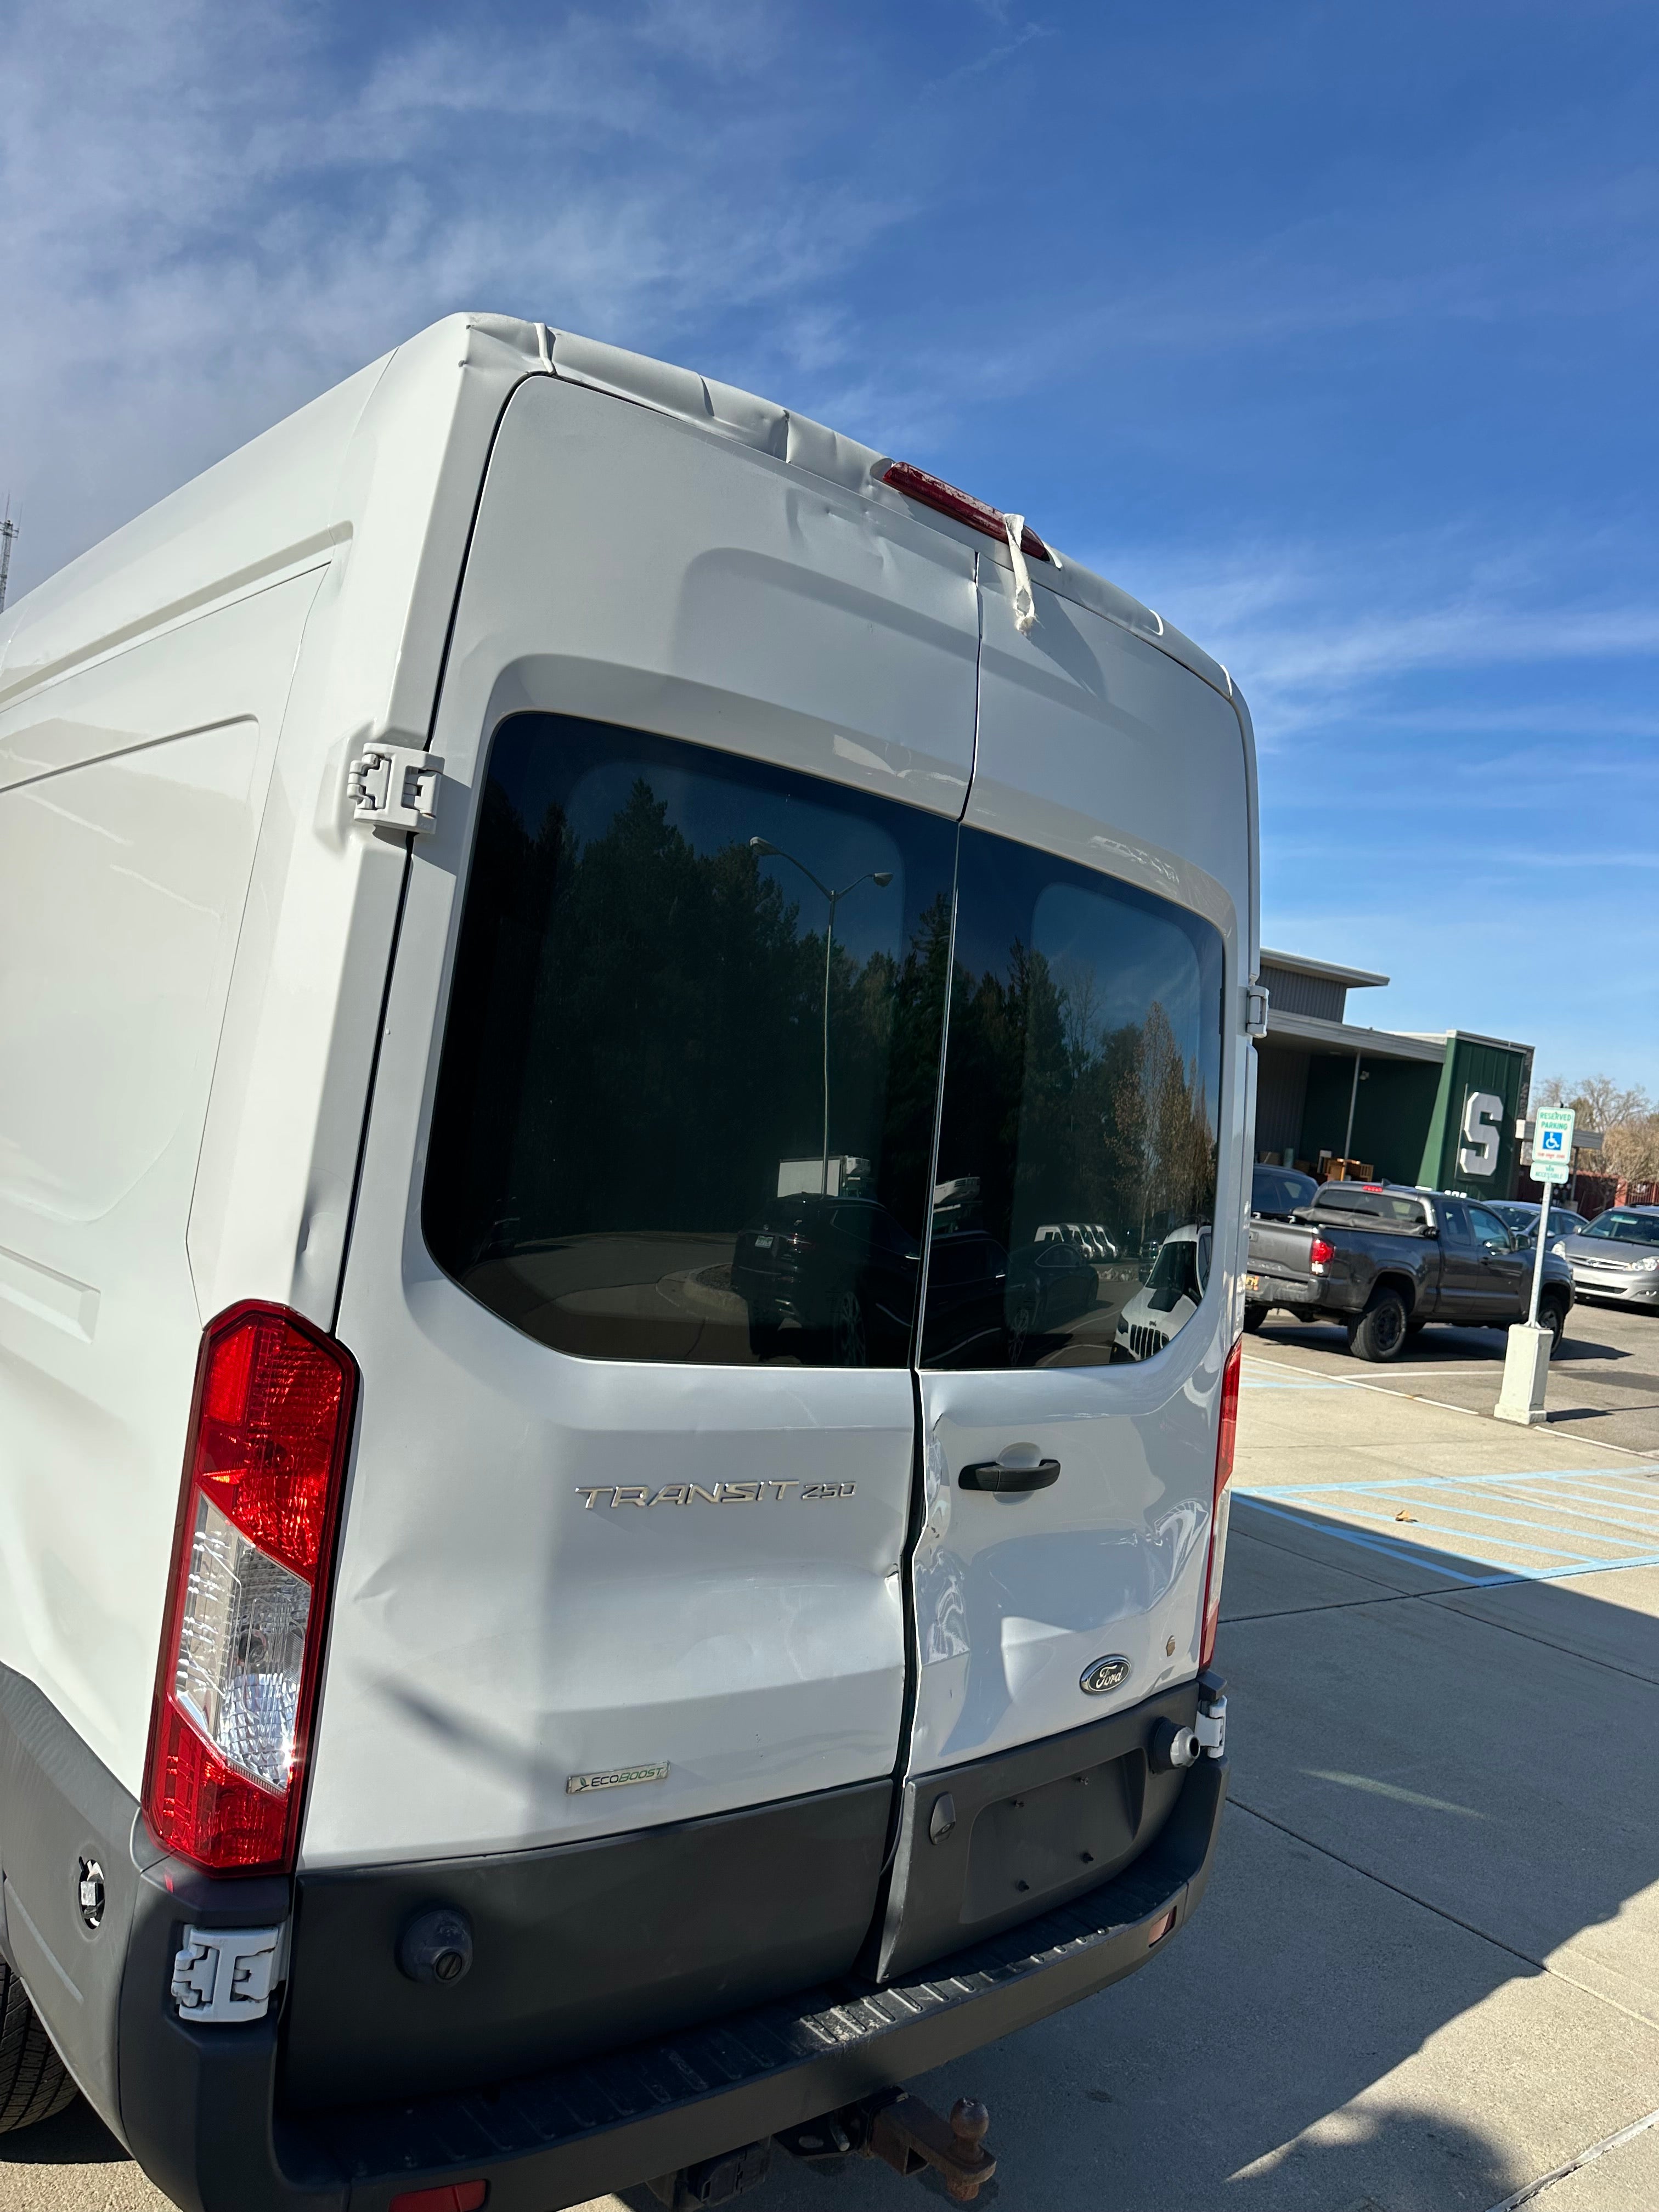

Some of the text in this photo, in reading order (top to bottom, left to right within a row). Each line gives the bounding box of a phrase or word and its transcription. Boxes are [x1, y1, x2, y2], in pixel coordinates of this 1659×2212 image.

[1540, 1112, 1571, 1121] RESERVED
[1541, 1121, 1568, 1130] PARKING
[1460, 1092, 1504, 1176] S
[575, 1480, 856, 1509] TRANSIT 250
[1096, 1664, 1124, 1689] Ford
[591, 1767, 664, 1787] ECOBOOST
